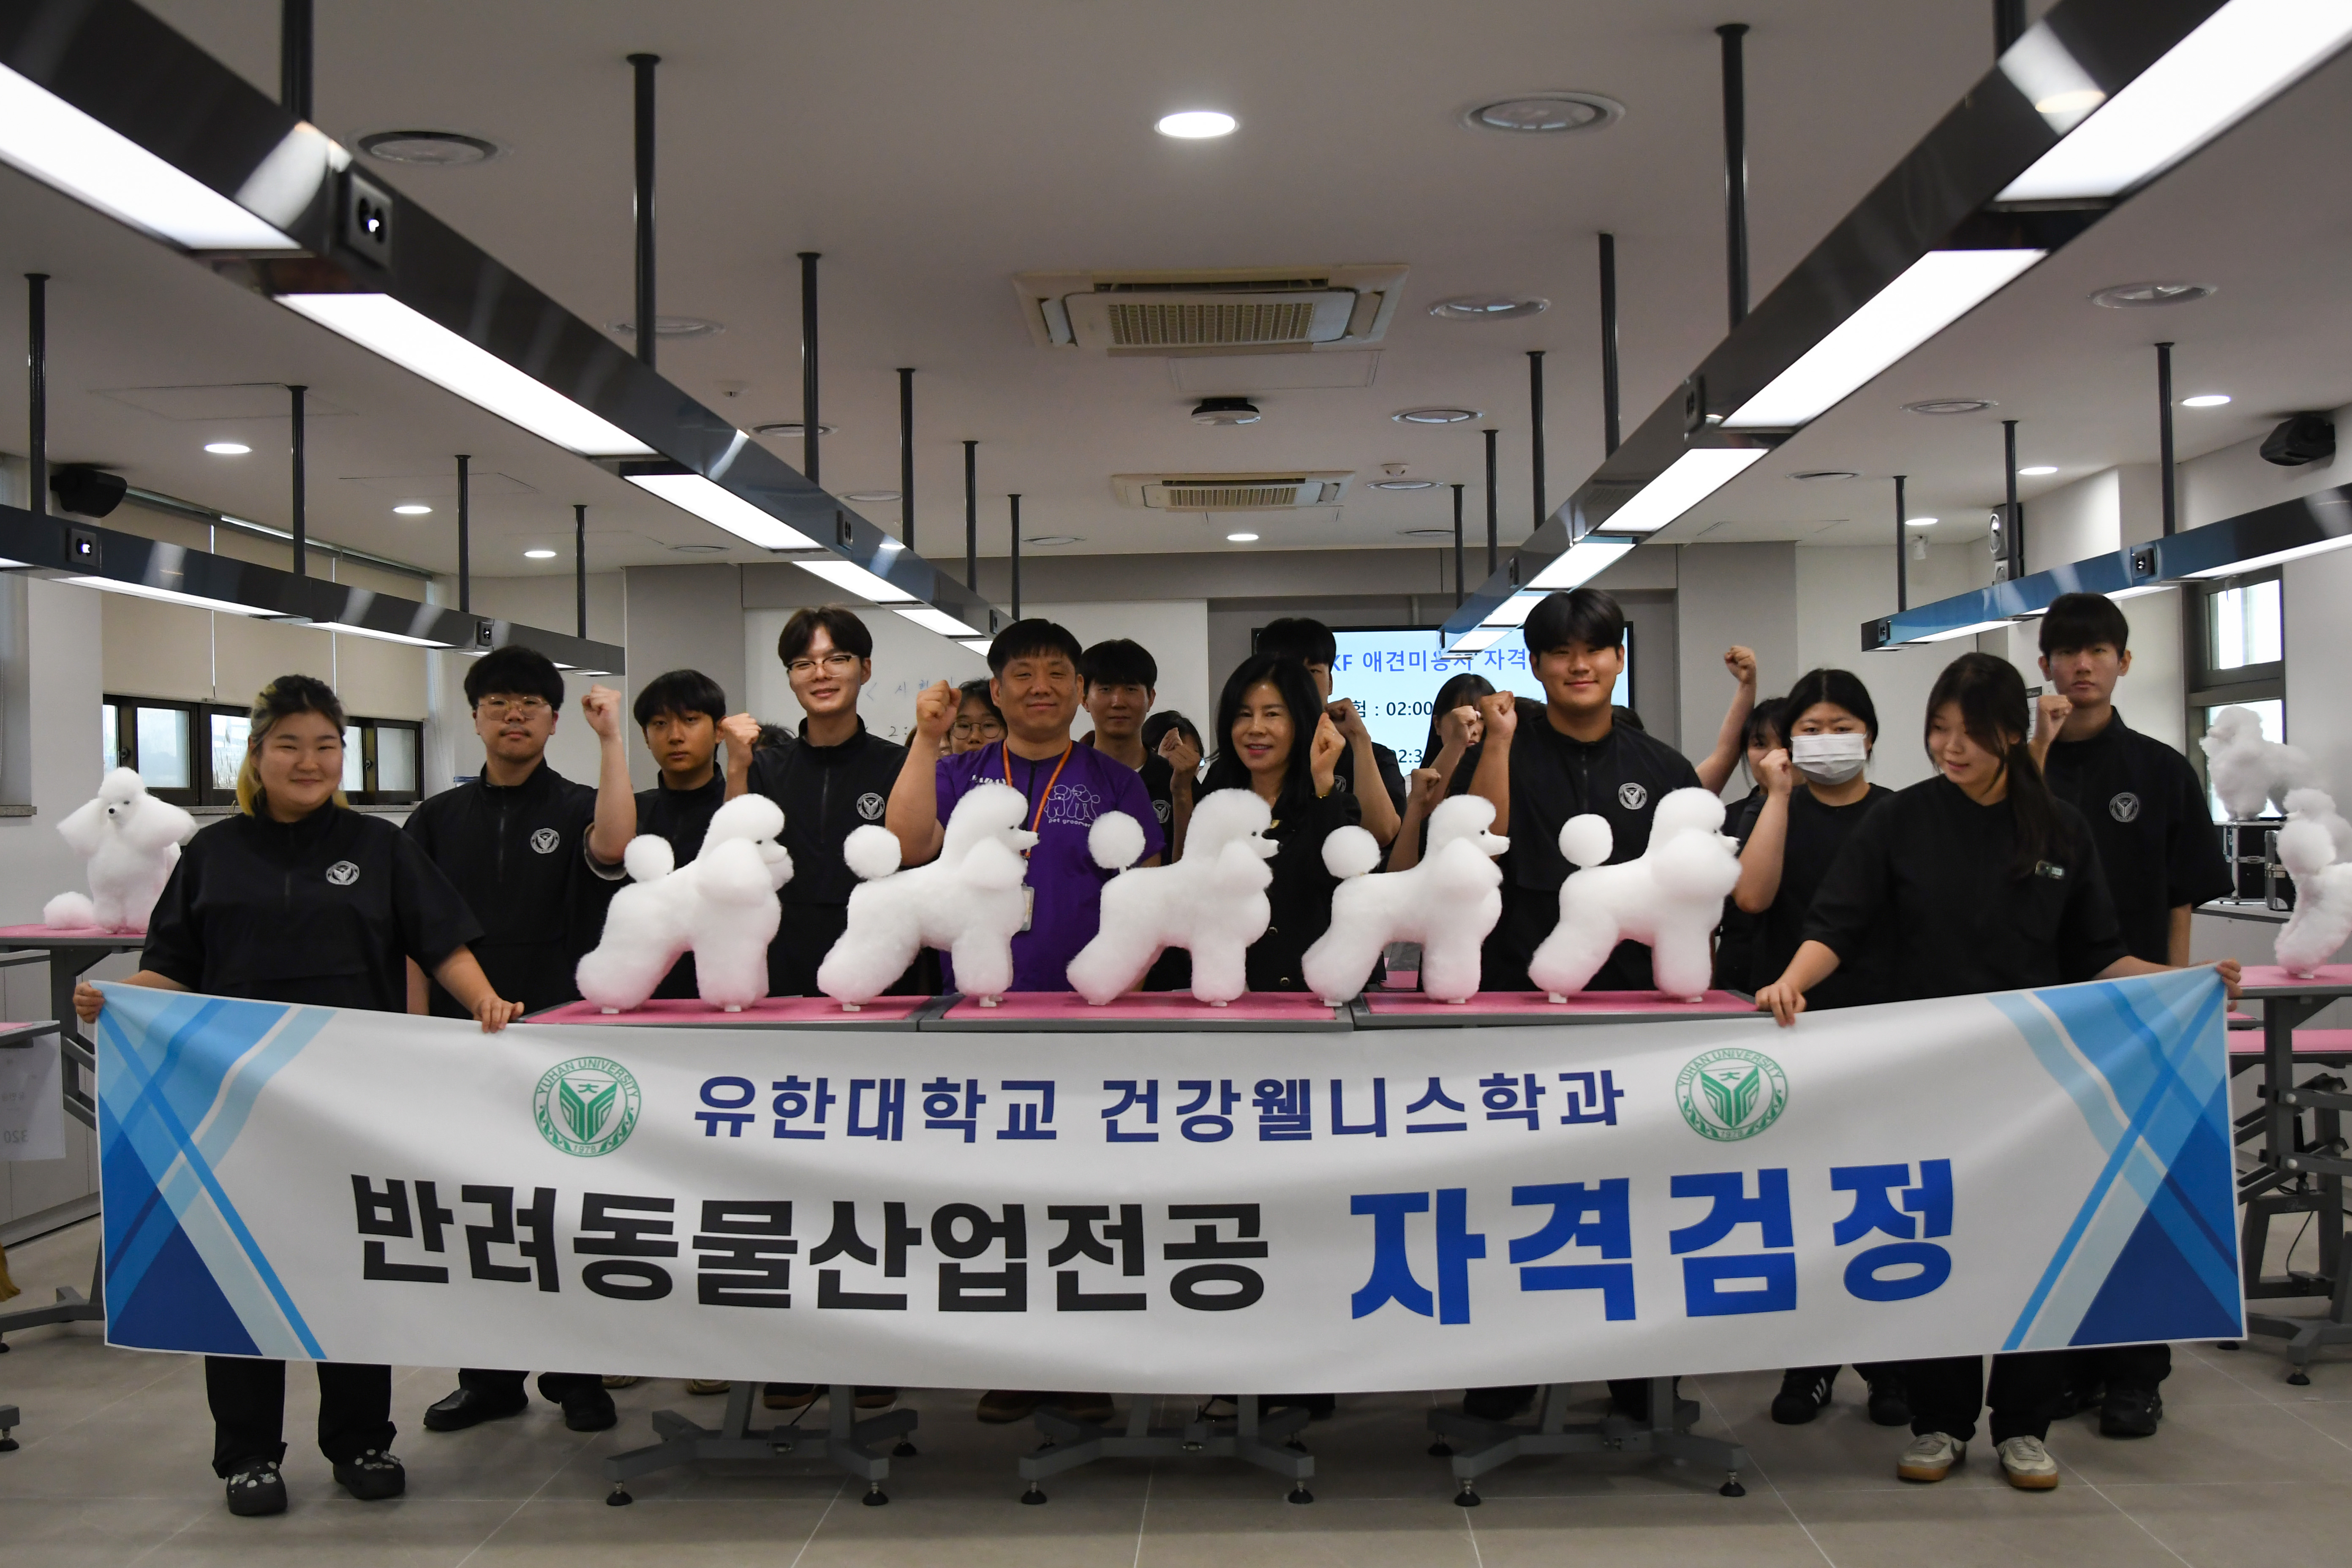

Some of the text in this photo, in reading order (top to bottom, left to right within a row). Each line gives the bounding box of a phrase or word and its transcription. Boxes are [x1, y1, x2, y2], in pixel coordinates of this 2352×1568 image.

[1386, 701, 1433, 716] 02:00
[1398, 749, 1423, 763] 2:3
[537, 1059, 640, 1097] YUHAN UNIVERSITY
[1677, 1050, 1783, 1086] YUHAN UNIVERSITY
[695, 1070, 1624, 1143] 유한대학교 건강웰니스학과
[573, 1145, 596, 1153] 1978
[351, 1158, 1954, 1325] 반려동물산업전공 자격검정
